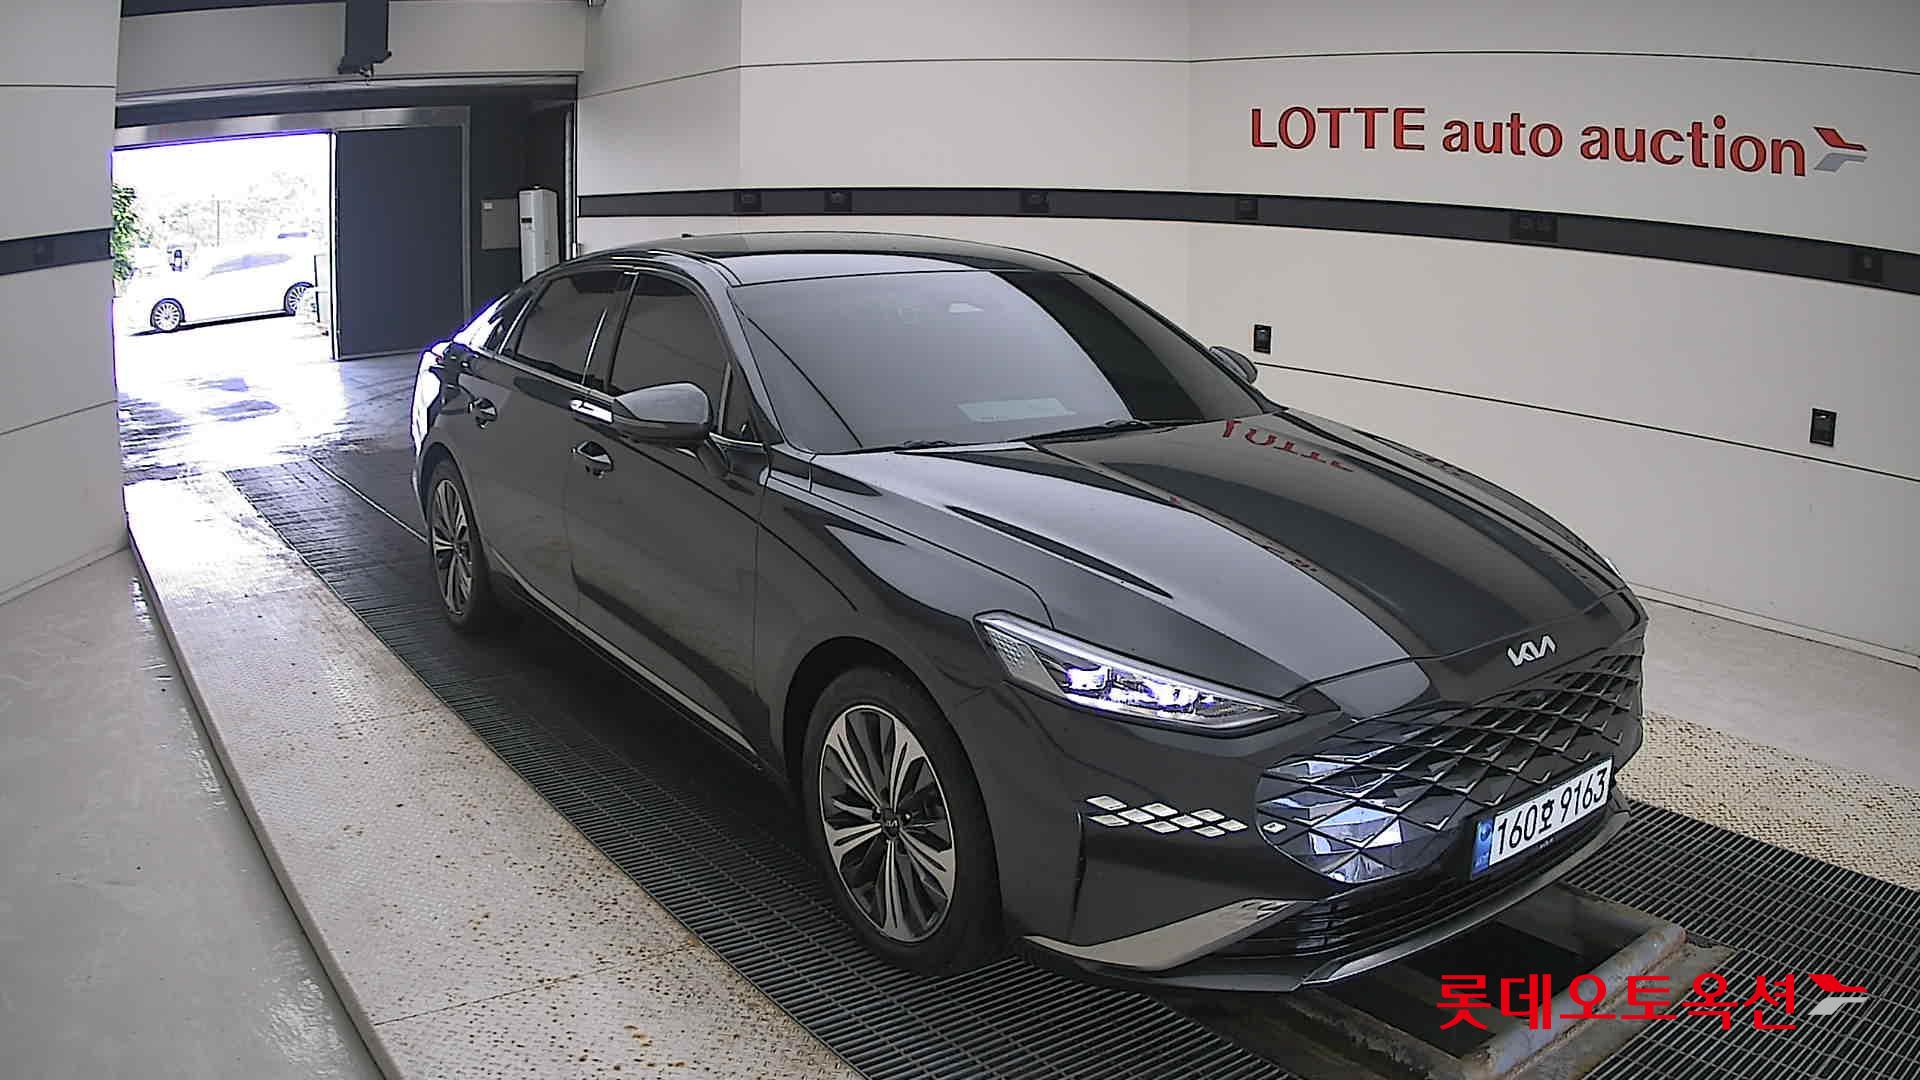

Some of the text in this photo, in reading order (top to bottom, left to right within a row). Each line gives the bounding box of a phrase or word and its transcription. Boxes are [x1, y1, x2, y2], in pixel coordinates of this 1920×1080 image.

[1251, 105, 1807, 177] LOTTE auto auction
[1498, 767, 1608, 856] 160호 9163
